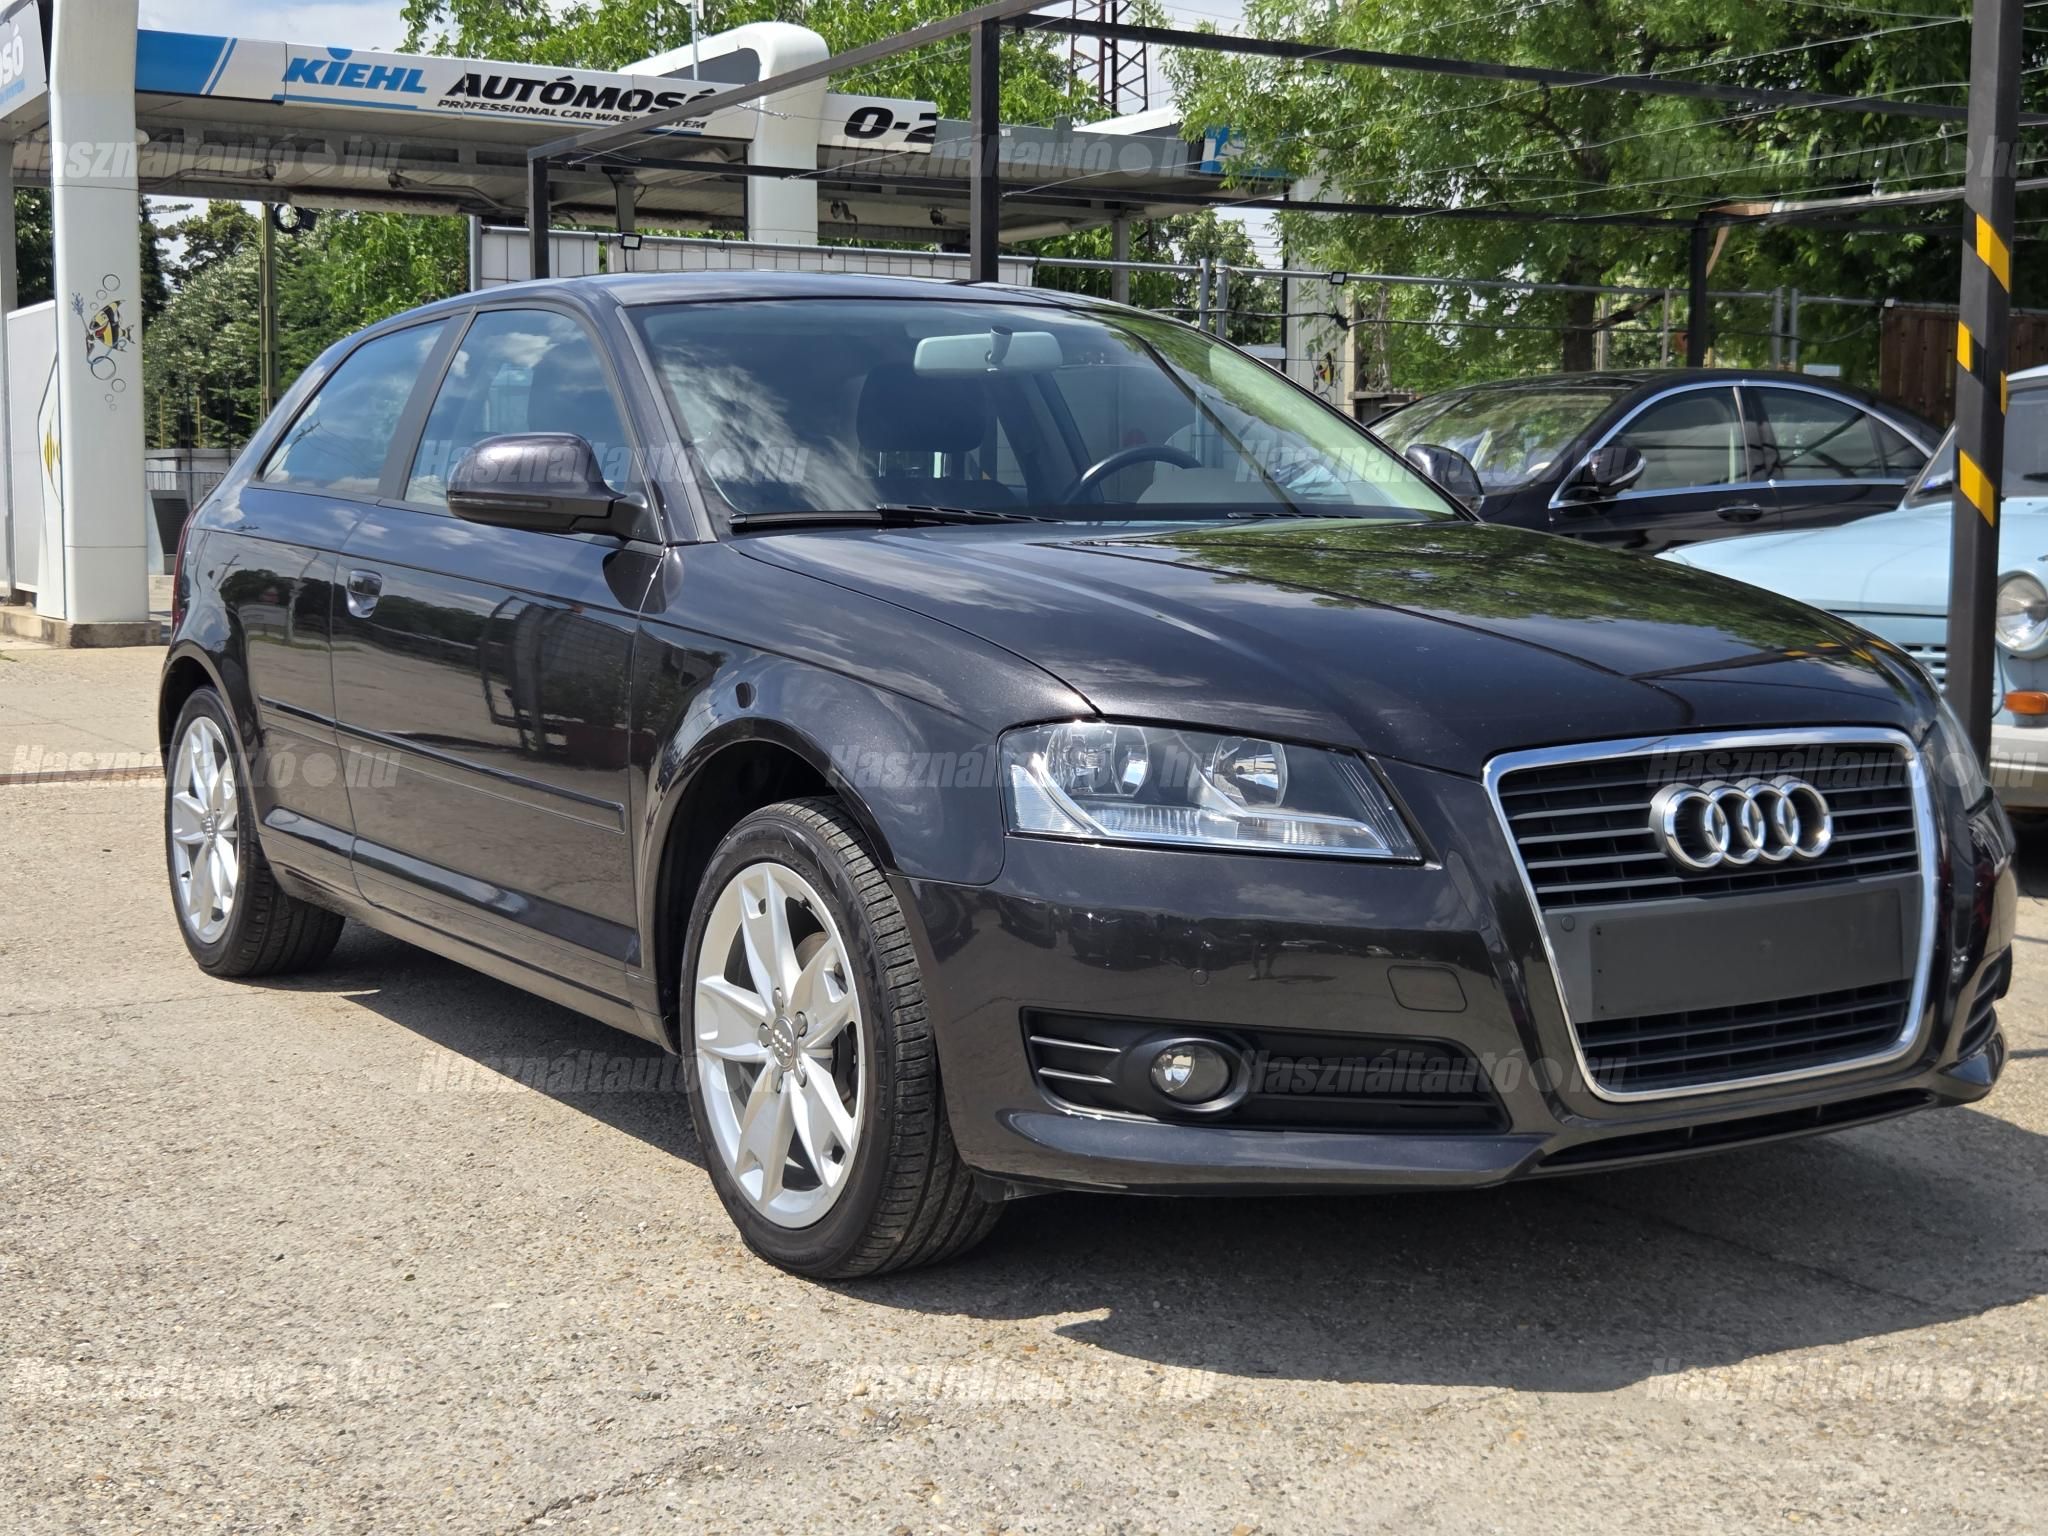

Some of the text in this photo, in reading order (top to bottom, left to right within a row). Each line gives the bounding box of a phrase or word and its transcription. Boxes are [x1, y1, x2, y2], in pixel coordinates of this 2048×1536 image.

[0, 23, 24, 88] SÓ
[437, 99, 557, 117] PROFESSIONAL
[560, 110, 592, 120] CAR
[595, 112, 638, 122] WAS
